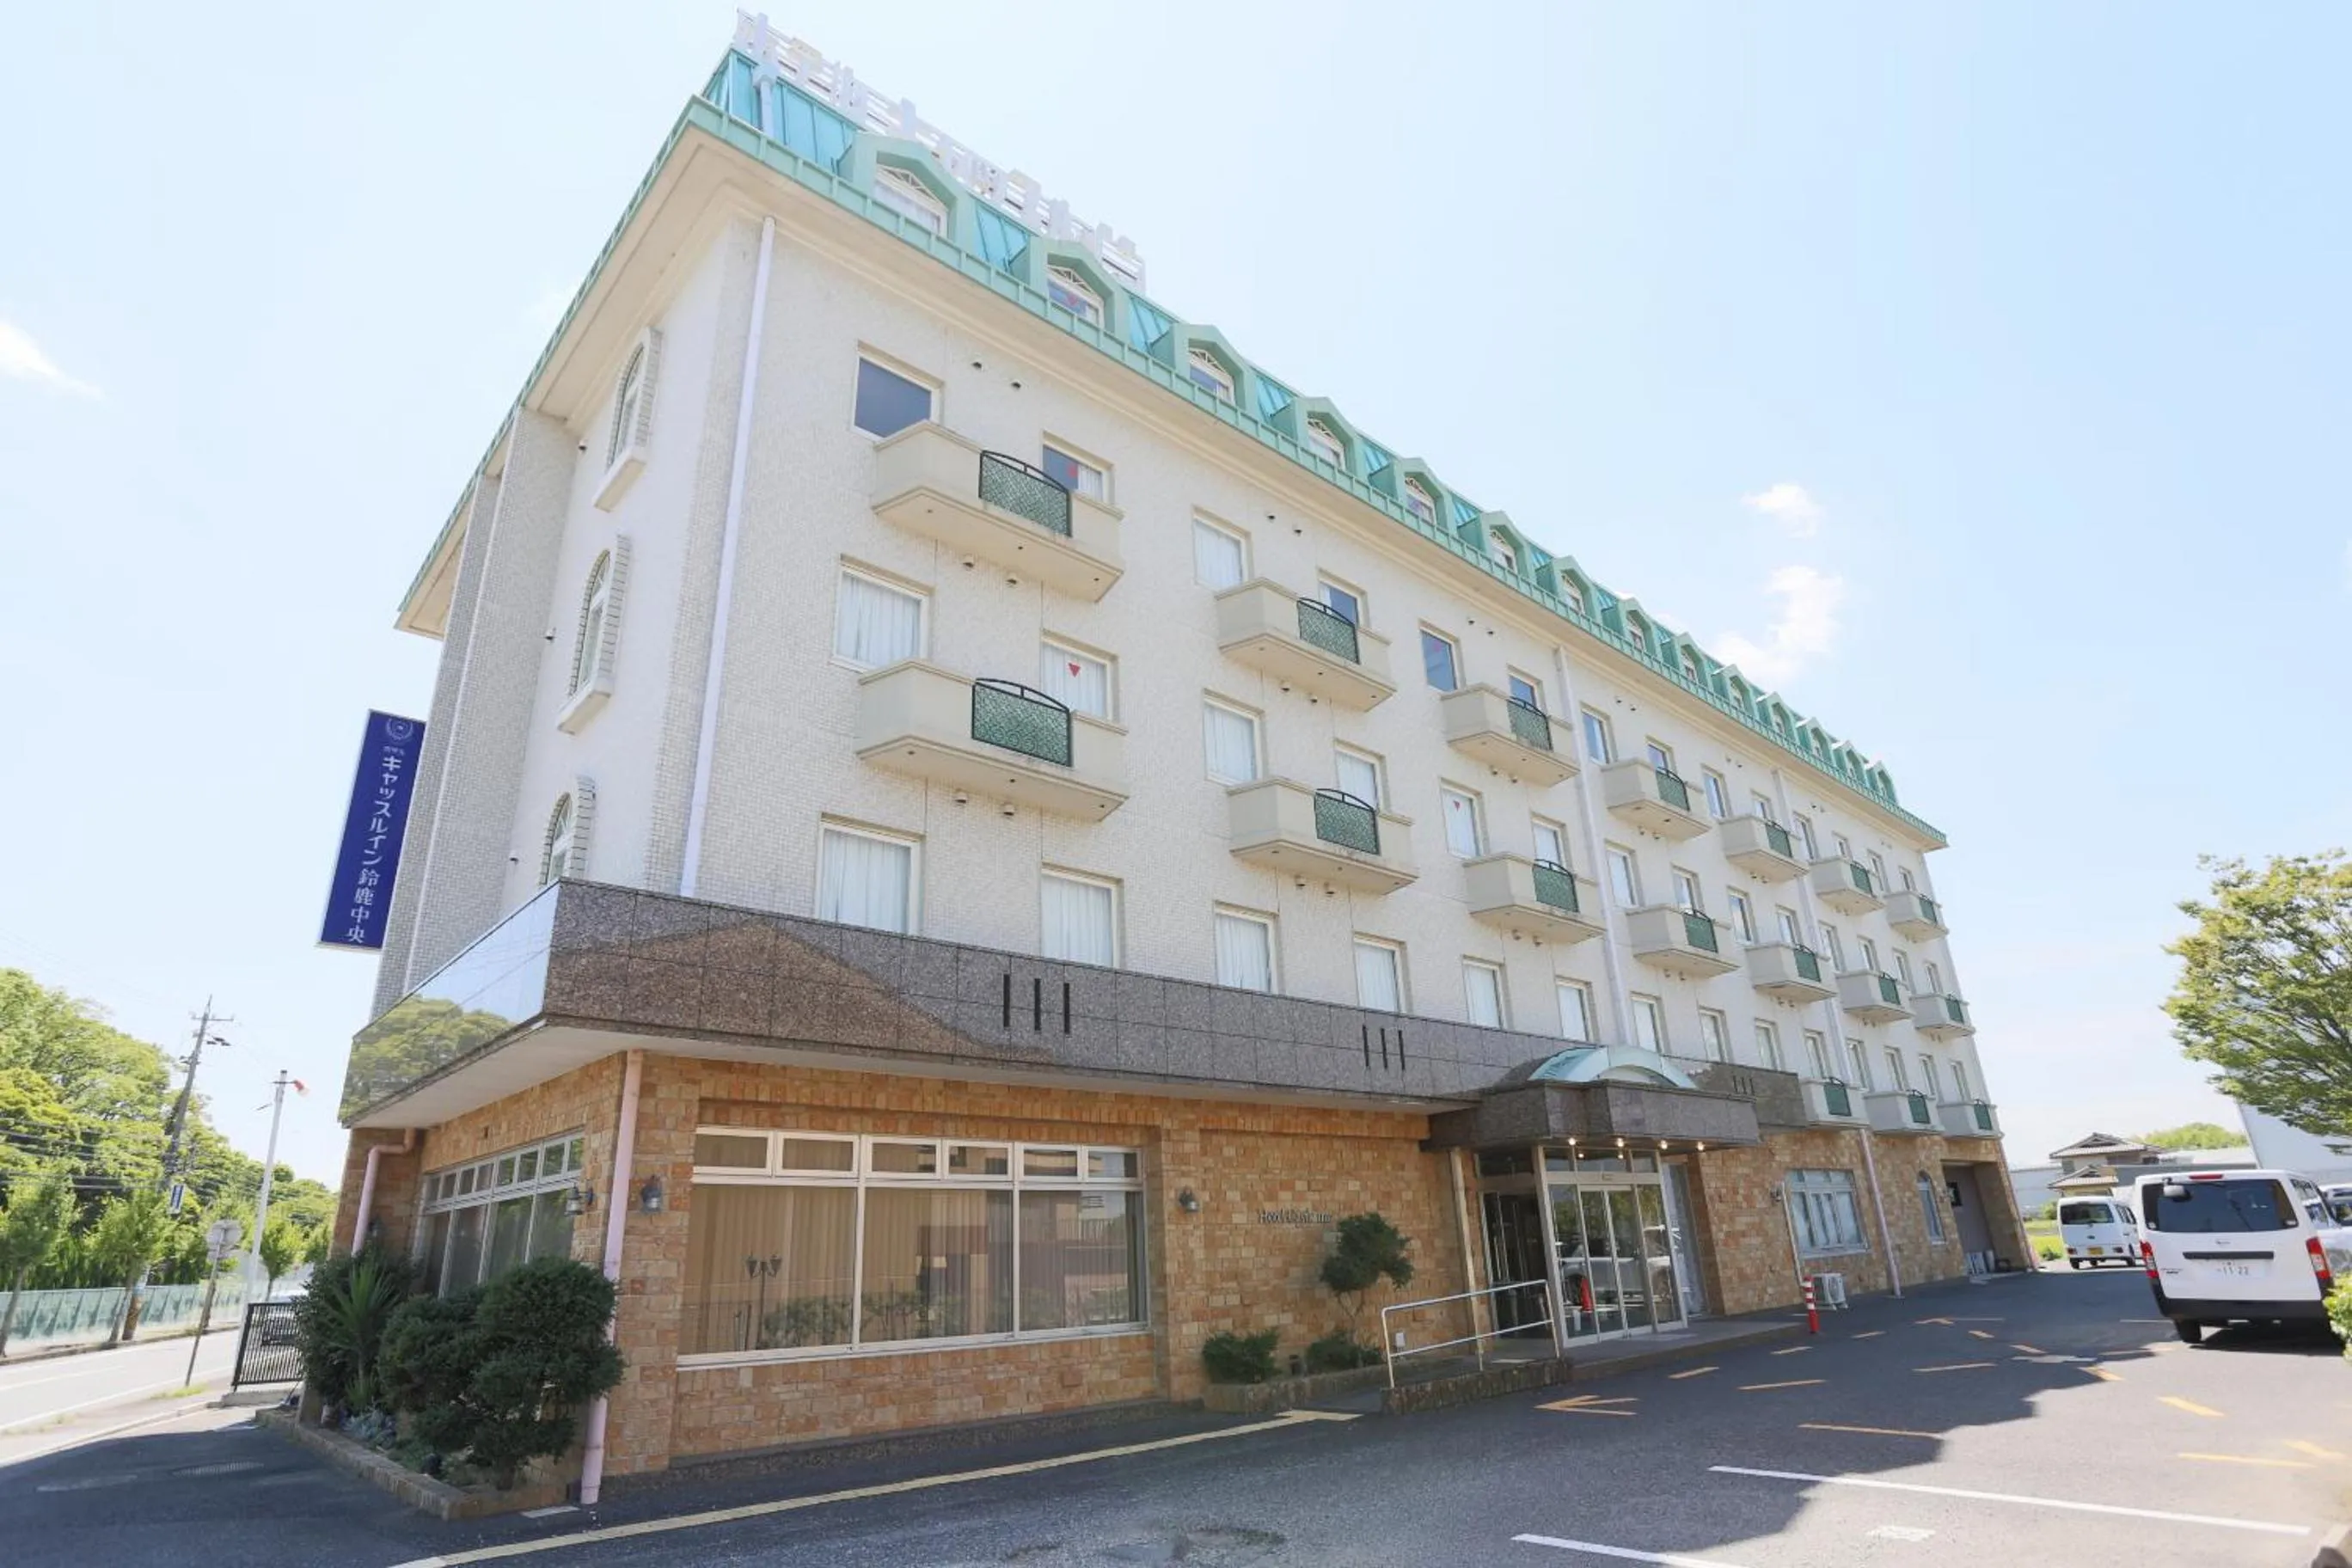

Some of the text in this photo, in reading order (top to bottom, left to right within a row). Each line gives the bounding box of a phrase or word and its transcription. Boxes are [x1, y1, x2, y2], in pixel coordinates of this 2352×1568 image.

[346, 756, 402, 944] キャッスルイン鈴鹿中央
